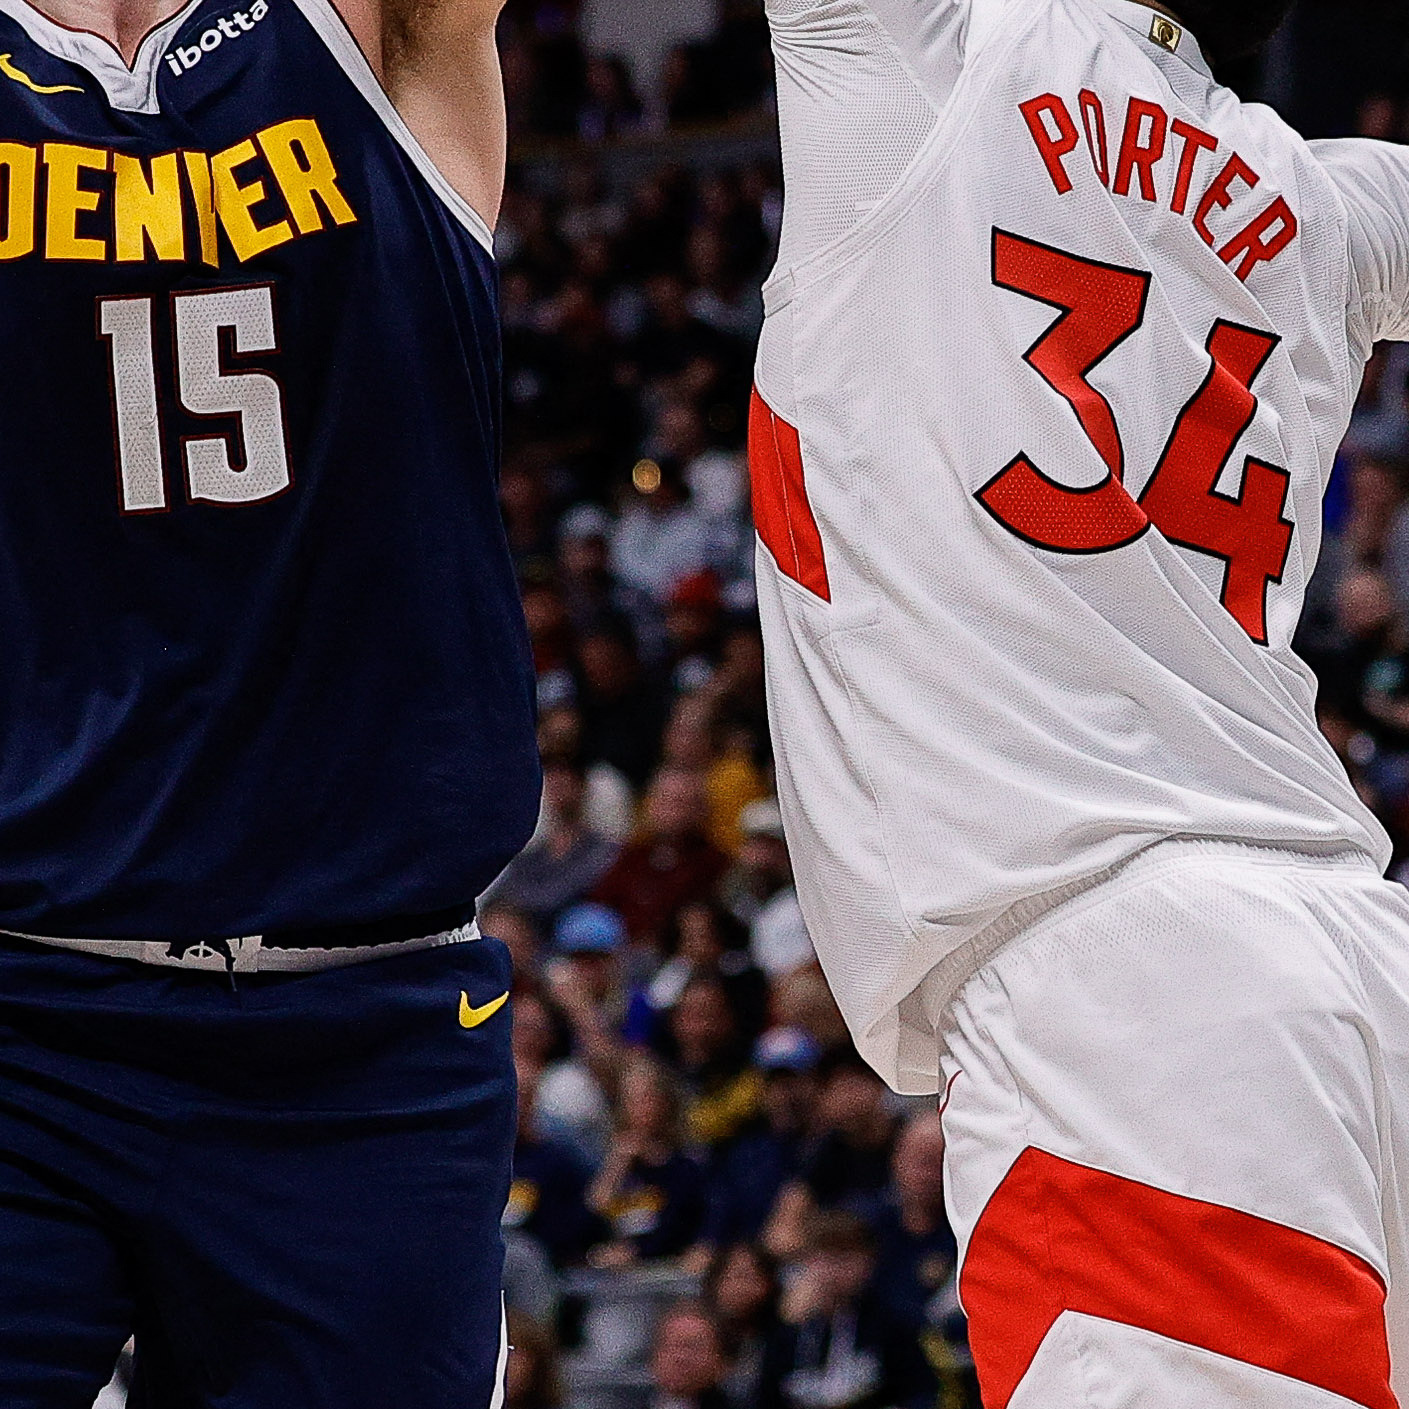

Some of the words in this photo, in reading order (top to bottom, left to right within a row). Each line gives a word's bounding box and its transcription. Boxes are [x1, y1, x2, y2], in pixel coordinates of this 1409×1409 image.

[1018, 88, 1297, 282] PORTER
[95, 282, 294, 515] 15
[972, 225, 1294, 645] 34
